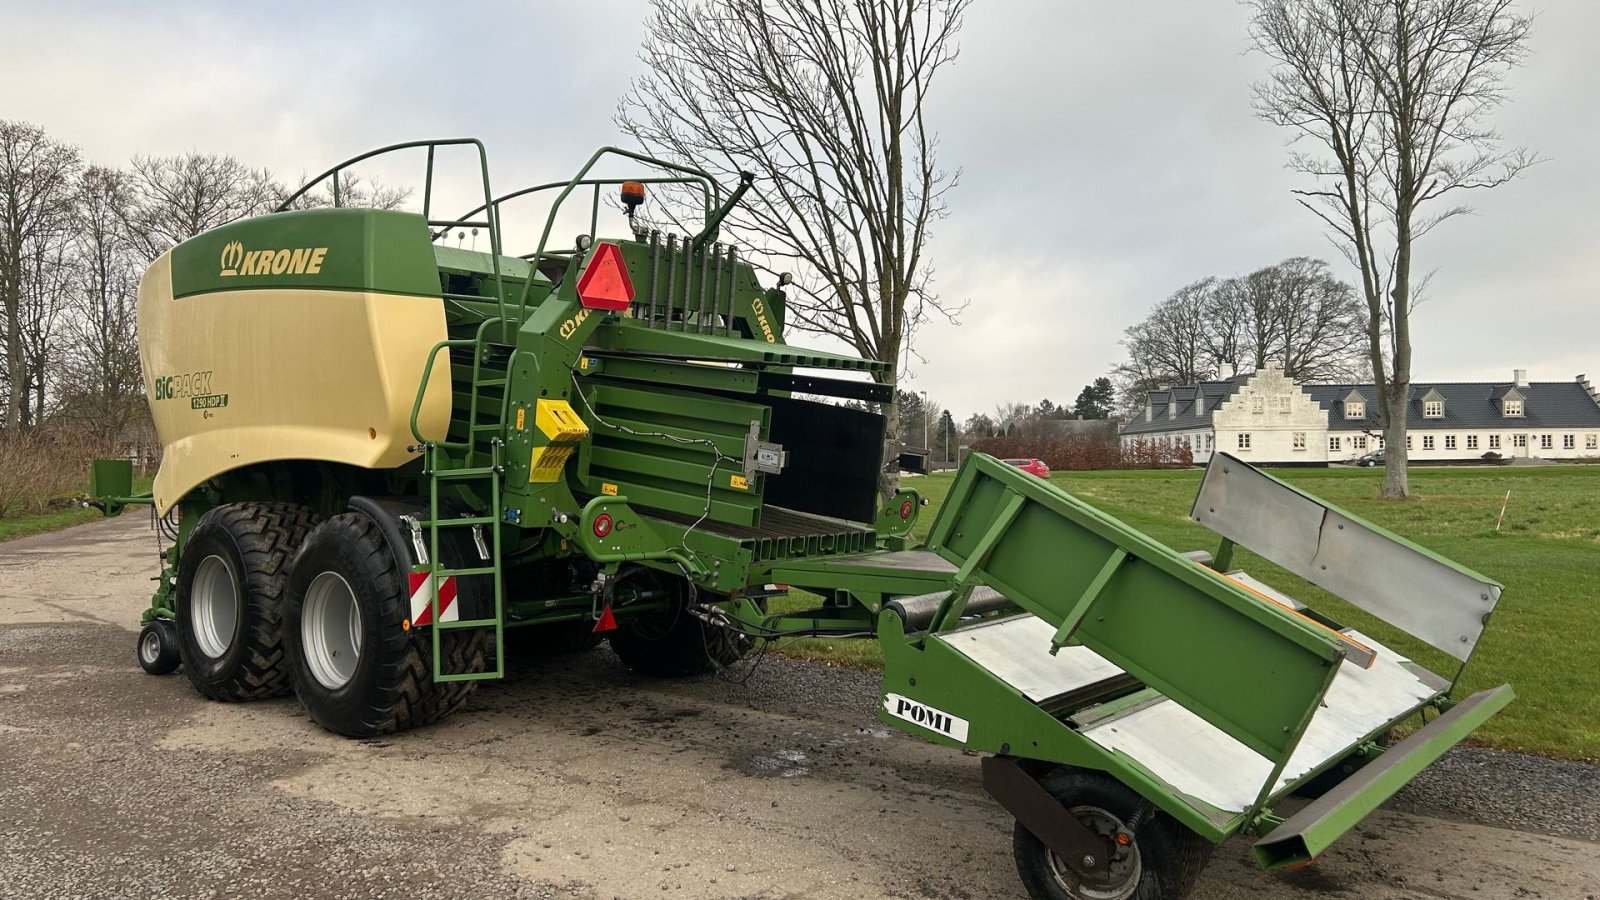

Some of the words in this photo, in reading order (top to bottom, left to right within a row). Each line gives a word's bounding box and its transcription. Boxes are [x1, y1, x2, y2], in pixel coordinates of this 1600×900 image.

[239, 247, 328, 276] KRONE
[757, 314, 775, 344] KRO
[207, 396, 219, 408] HDP
[896, 699, 952, 734] POMI
